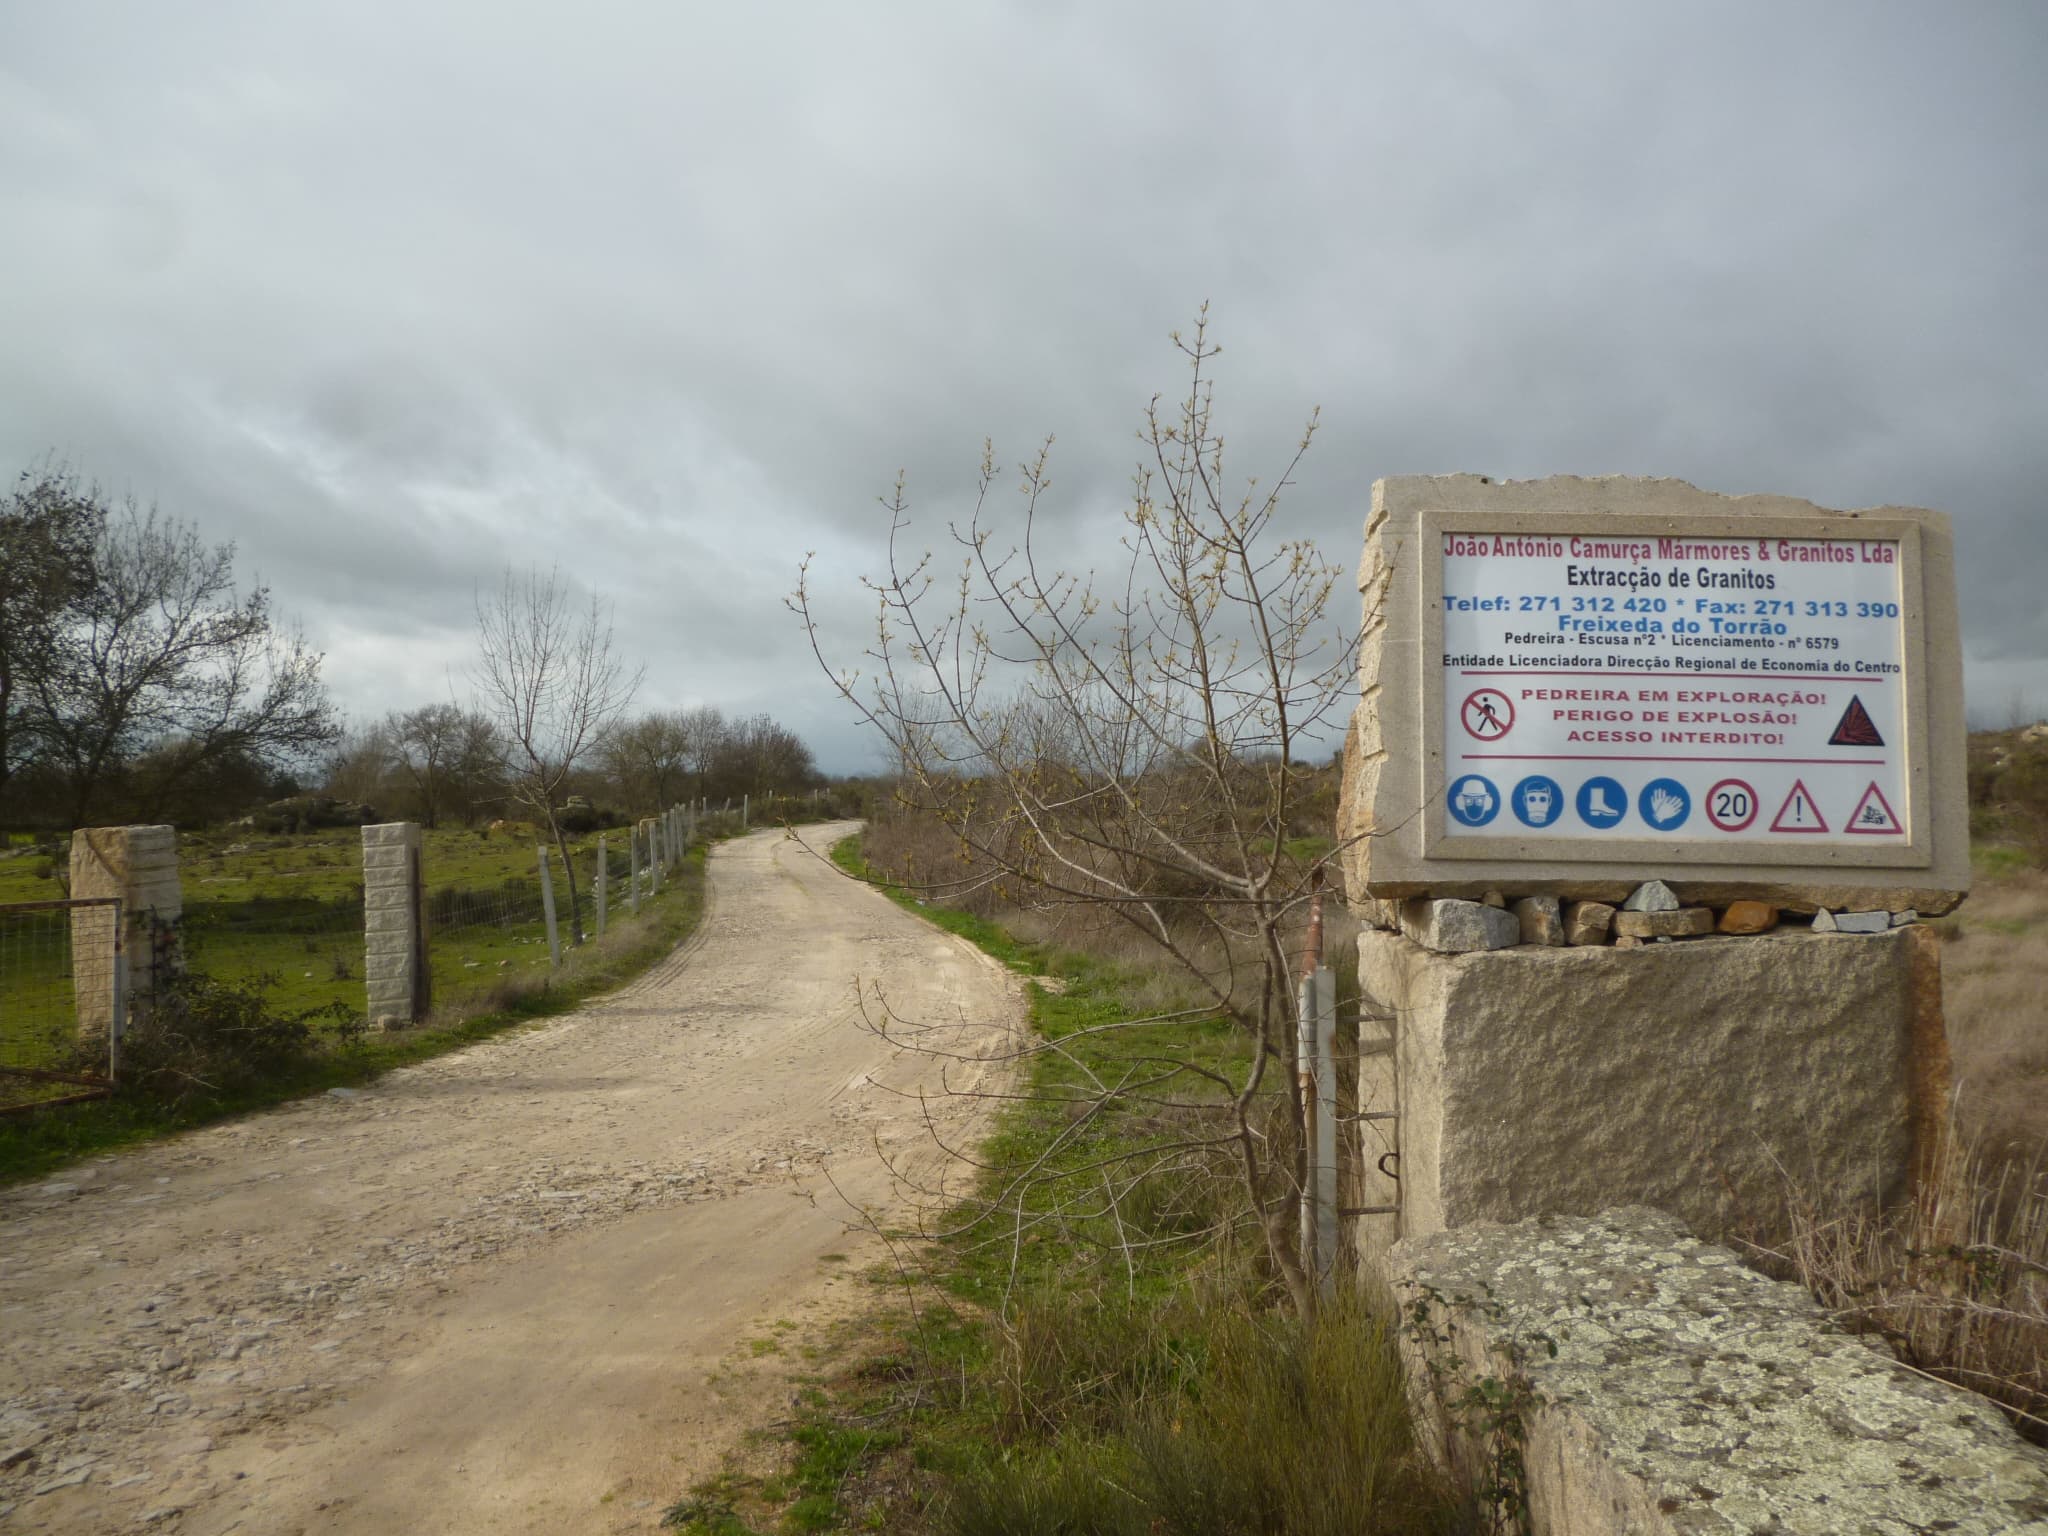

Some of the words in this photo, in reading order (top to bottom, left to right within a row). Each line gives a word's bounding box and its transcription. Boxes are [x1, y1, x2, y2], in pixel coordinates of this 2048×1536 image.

[1444, 536, 1487, 556] João
[1493, 536, 1563, 557] António
[1570, 537, 1651, 564] Camurça
[1758, 540, 1770, 561] &
[1777, 540, 1854, 563] Granitos
[1862, 542, 1893, 563] Lda
[1567, 565, 1661, 592] Extracção
[1668, 567, 1690, 588] de
[1697, 568, 1775, 589] Granitos
[1443, 596, 1510, 611] Telef:
[1520, 597, 1560, 611] 271
[1572, 598, 1614, 612] 312
[1624, 598, 1666, 612] 420
[1696, 599, 1745, 614] Fax:
[1754, 600, 1794, 615] 271
[1806, 602, 1847, 616] 313
[1857, 603, 1898, 617] 390
[1558, 616, 1662, 632] Freixeda
[1672, 618, 1700, 633] do
[1710, 618, 1787, 635] Torrão
[1505, 633, 1564, 644] Pedreira
[1579, 633, 1628, 645] Escusa
[1672, 635, 1774, 648] Licenciamento
[1806, 638, 1839, 649] 6579
[1443, 655, 1504, 666] Entidade
[1510, 655, 1602, 667] Licenciadora
[1607, 656, 1670, 671] Direcção
[1676, 657, 1735, 671] Regional
[1741, 659, 1757, 670] de
[1762, 659, 1829, 671] Economia
[1834, 660, 1850, 672] do
[1855, 661, 1900, 673] Centro
[1522, 689, 1629, 701] PEDREIRA
[1639, 691, 1668, 701] EM
[1677, 691, 1826, 707] EXPLORAÇÃO!
[1554, 710, 1633, 721] PERIGO
[1643, 711, 1668, 722] DE
[1678, 711, 1797, 724] EXPLOSÃO!
[1567, 731, 1652, 742] ACESSO
[1662, 732, 1783, 744] INTERDITO!
[1717, 793, 1747, 817] 20
